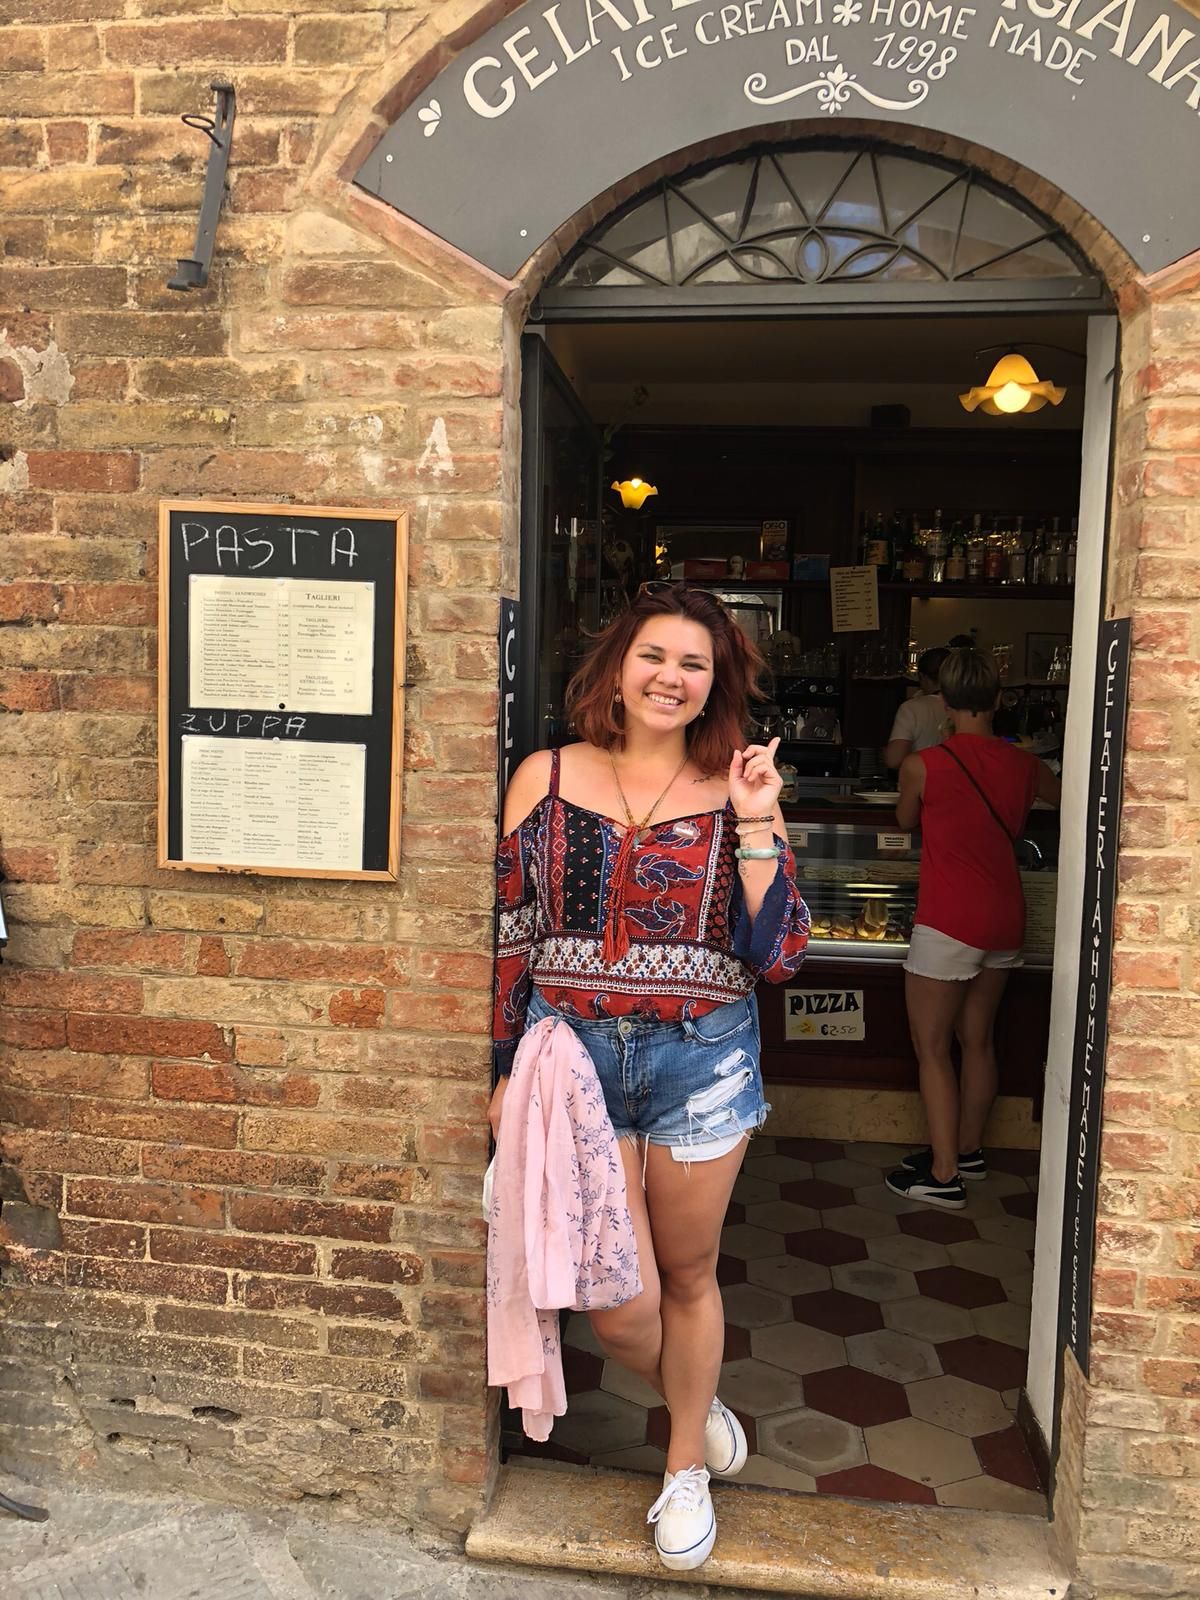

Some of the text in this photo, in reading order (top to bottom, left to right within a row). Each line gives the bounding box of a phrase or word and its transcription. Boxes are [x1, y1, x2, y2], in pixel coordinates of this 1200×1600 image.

[610, 0, 1098, 86] ICE CREAM HOME MADE
[785, 32, 958, 80] DAL 1998
[181, 522, 358, 569] PASTA
[179, 712, 307, 737] ZUPPA
[789, 992, 861, 1016] PIZZA
[1084, 951, 1099, 1076] HOME
[1076, 1081, 1091, 1190] MADE
